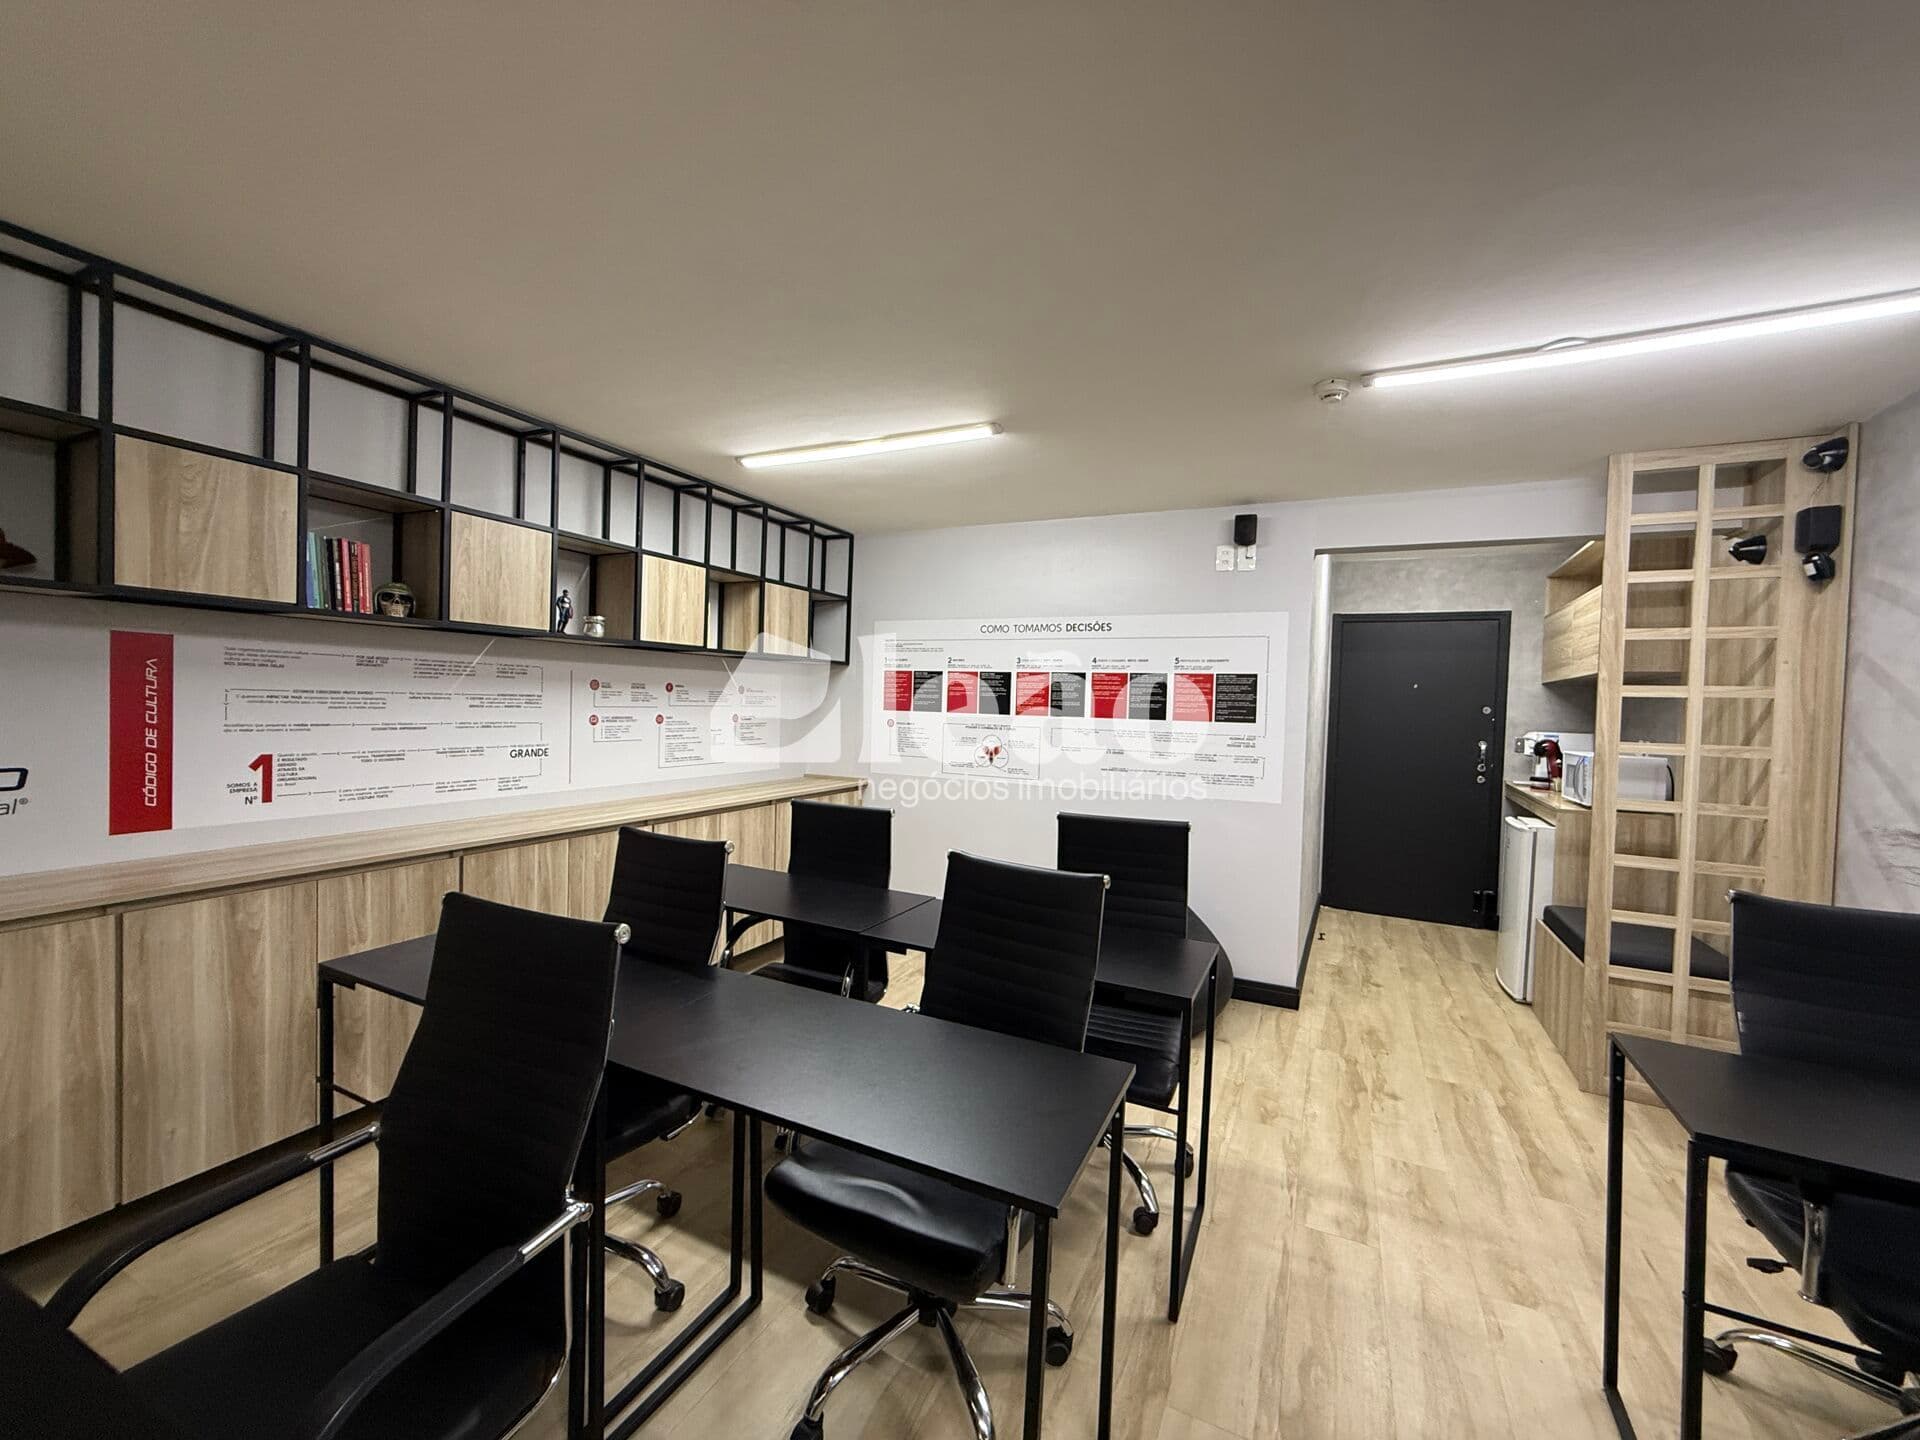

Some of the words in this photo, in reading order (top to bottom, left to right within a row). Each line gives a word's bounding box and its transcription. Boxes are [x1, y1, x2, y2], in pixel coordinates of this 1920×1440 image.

[980, 624, 1010, 634] COMO
[1013, 623, 1062, 633] TOMAMOS
[1065, 620, 1113, 632] DECISÕES
[145, 658, 159, 724] CULTURA
[145, 727, 158, 749] DE
[509, 748, 550, 759] GRANDE
[142, 752, 157, 807] CÓDIGO
[247, 754, 273, 804] 1
